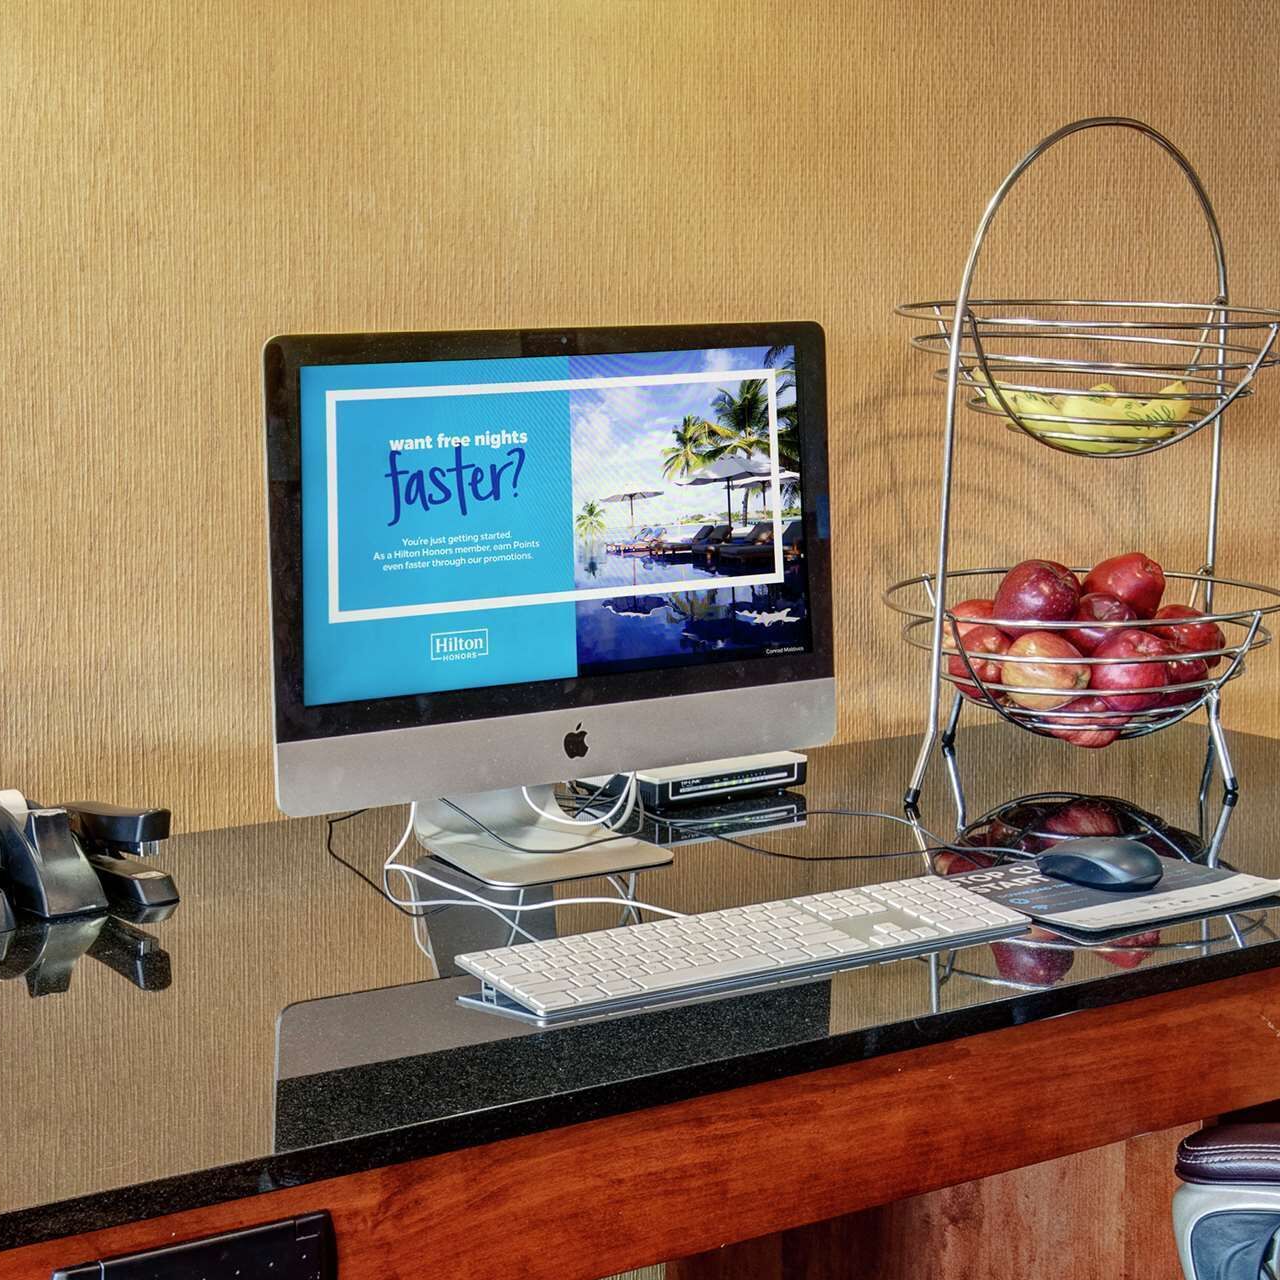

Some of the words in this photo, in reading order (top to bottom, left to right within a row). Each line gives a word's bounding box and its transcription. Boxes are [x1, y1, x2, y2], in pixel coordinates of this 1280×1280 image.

[389, 435, 433, 451] want
[437, 432, 471, 449] free
[474, 429, 528, 449] nights
[384, 442, 526, 527] faster?
[373, 552, 385, 561] As
[394, 548, 420, 559] Hilton
[422, 546, 453, 557] Honors
[513, 539, 540, 550] Points
[401, 536, 429, 547] You're
[430, 535, 446, 547] just
[448, 533, 479, 545] getting
[382, 563, 404, 572] even
[405, 560, 430, 570] faster
[432, 557, 467, 568] through
[468, 557, 482, 565] our
[483, 552, 534, 565] promotions.
[436, 636, 484, 654] Hilton
[442, 652, 478, 662] HONORS
